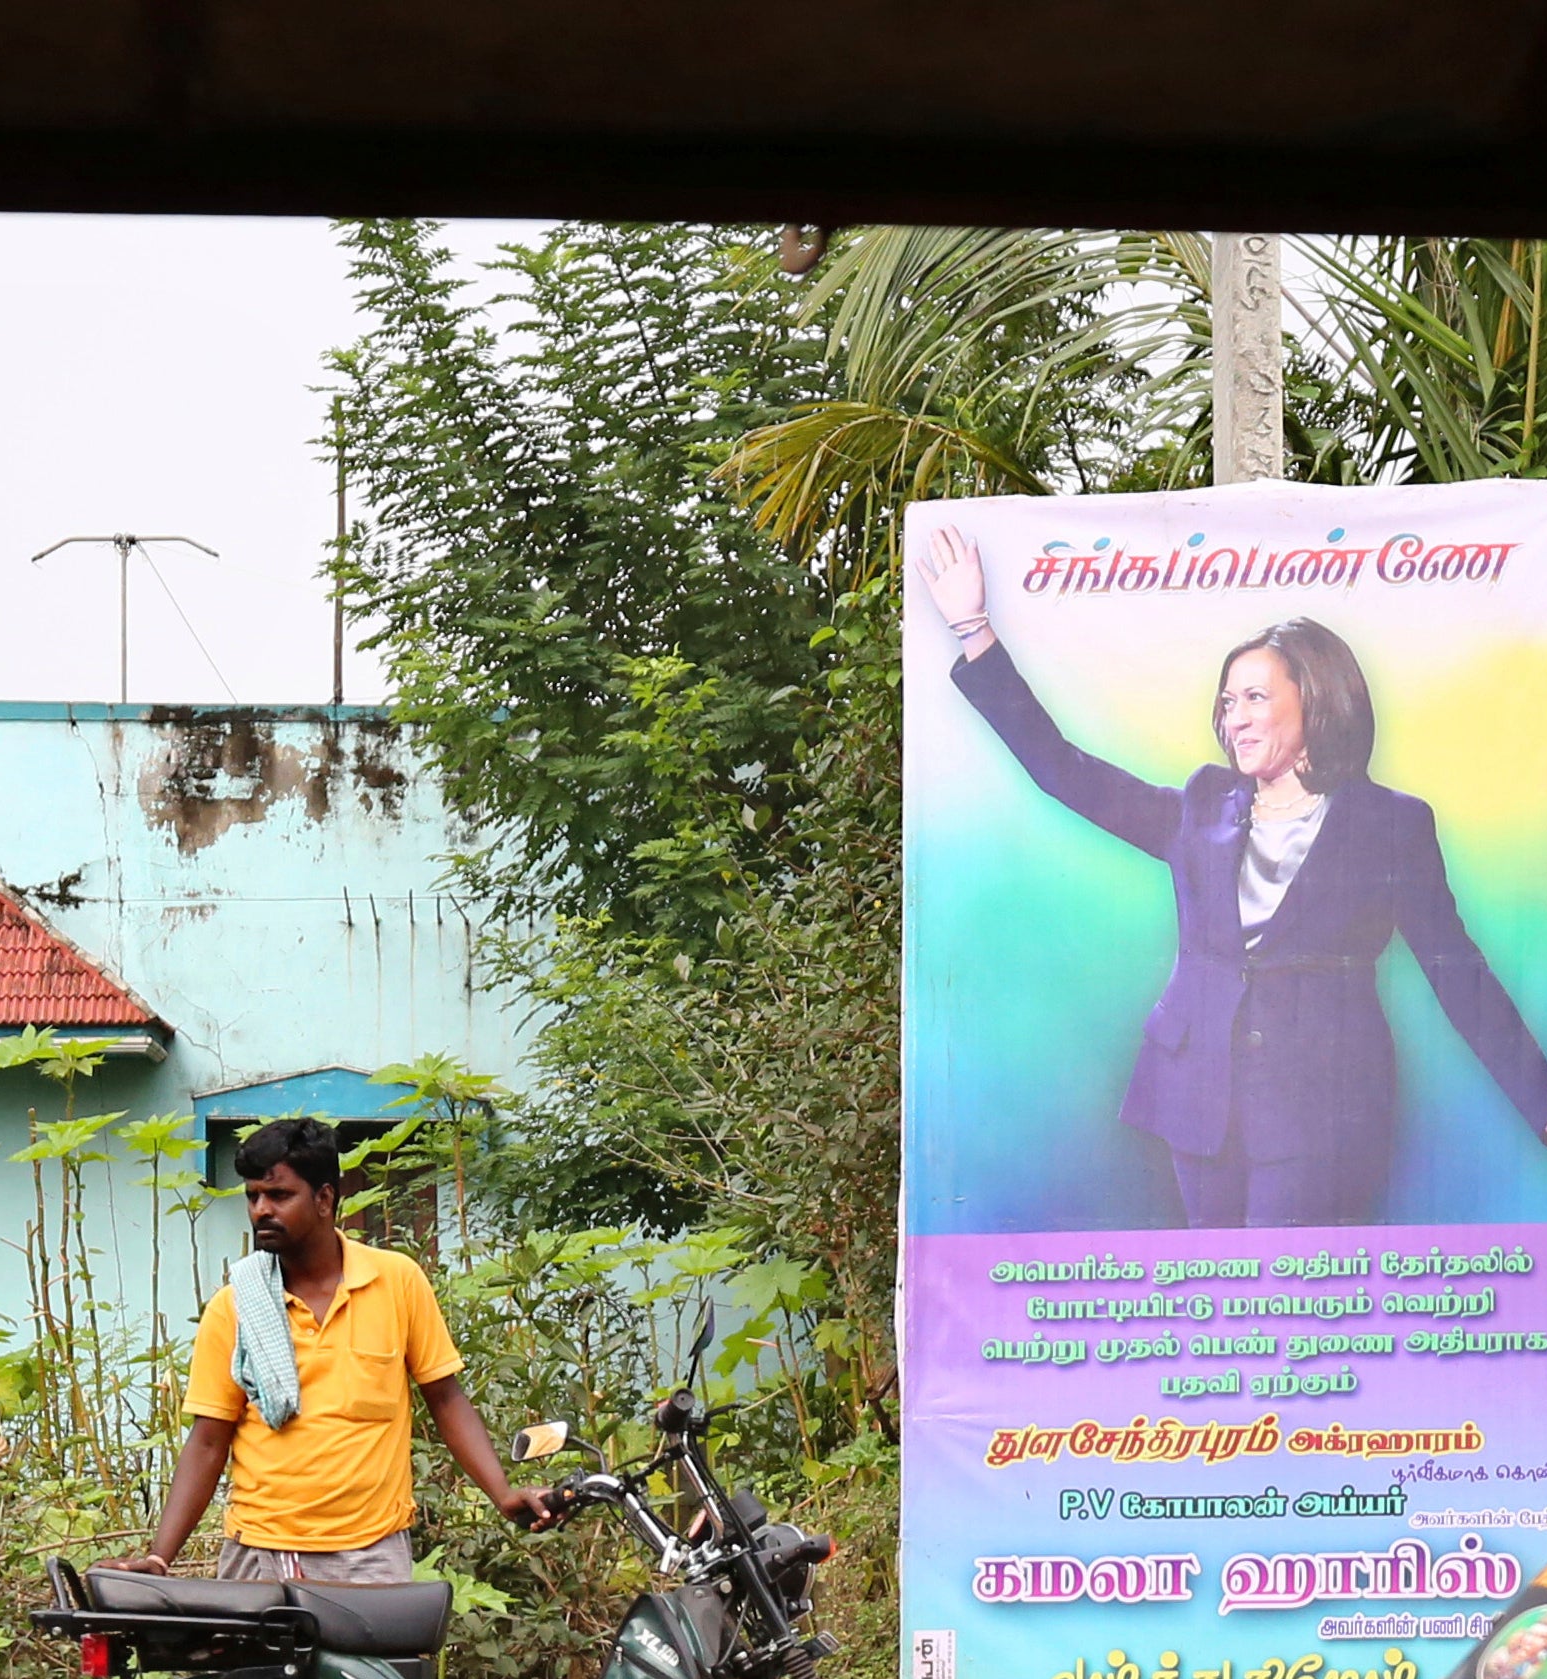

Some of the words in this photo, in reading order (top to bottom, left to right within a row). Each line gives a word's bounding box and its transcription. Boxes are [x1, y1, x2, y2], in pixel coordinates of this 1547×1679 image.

[990, 1253, 1145, 1282] அமெரிக்க
[1153, 1257, 1261, 1285] துணை
[1270, 1248, 1374, 1277] அதிபர்
[1380, 1246, 1534, 1277] தேர்தலில்
[1027, 1292, 1214, 1322] போட்டியிட்டு
[1224, 1288, 1374, 1319] மாபெரும்
[1382, 1289, 1496, 1320] வெற்றி
[982, 1335, 1086, 1365] பெற்று
[1095, 1330, 1181, 1361] முதல்
[1190, 1328, 1277, 1356] பெண்
[1286, 1329, 1394, 1358] துணை
[1161, 1369, 1240, 1398] பதவி
[1251, 1366, 1358, 1398] ஏற்கும்
[1059, 1489, 1115, 1520] P.V
[1121, 1488, 1288, 1520] கோபாலன்
[1295, 1484, 1407, 1518] அய்யர்
[972, 1551, 1199, 1604] கமலா
[1219, 1535, 1522, 1614] ஹாரிஸ்
[1420, 1615, 1464, 1638] பணி
